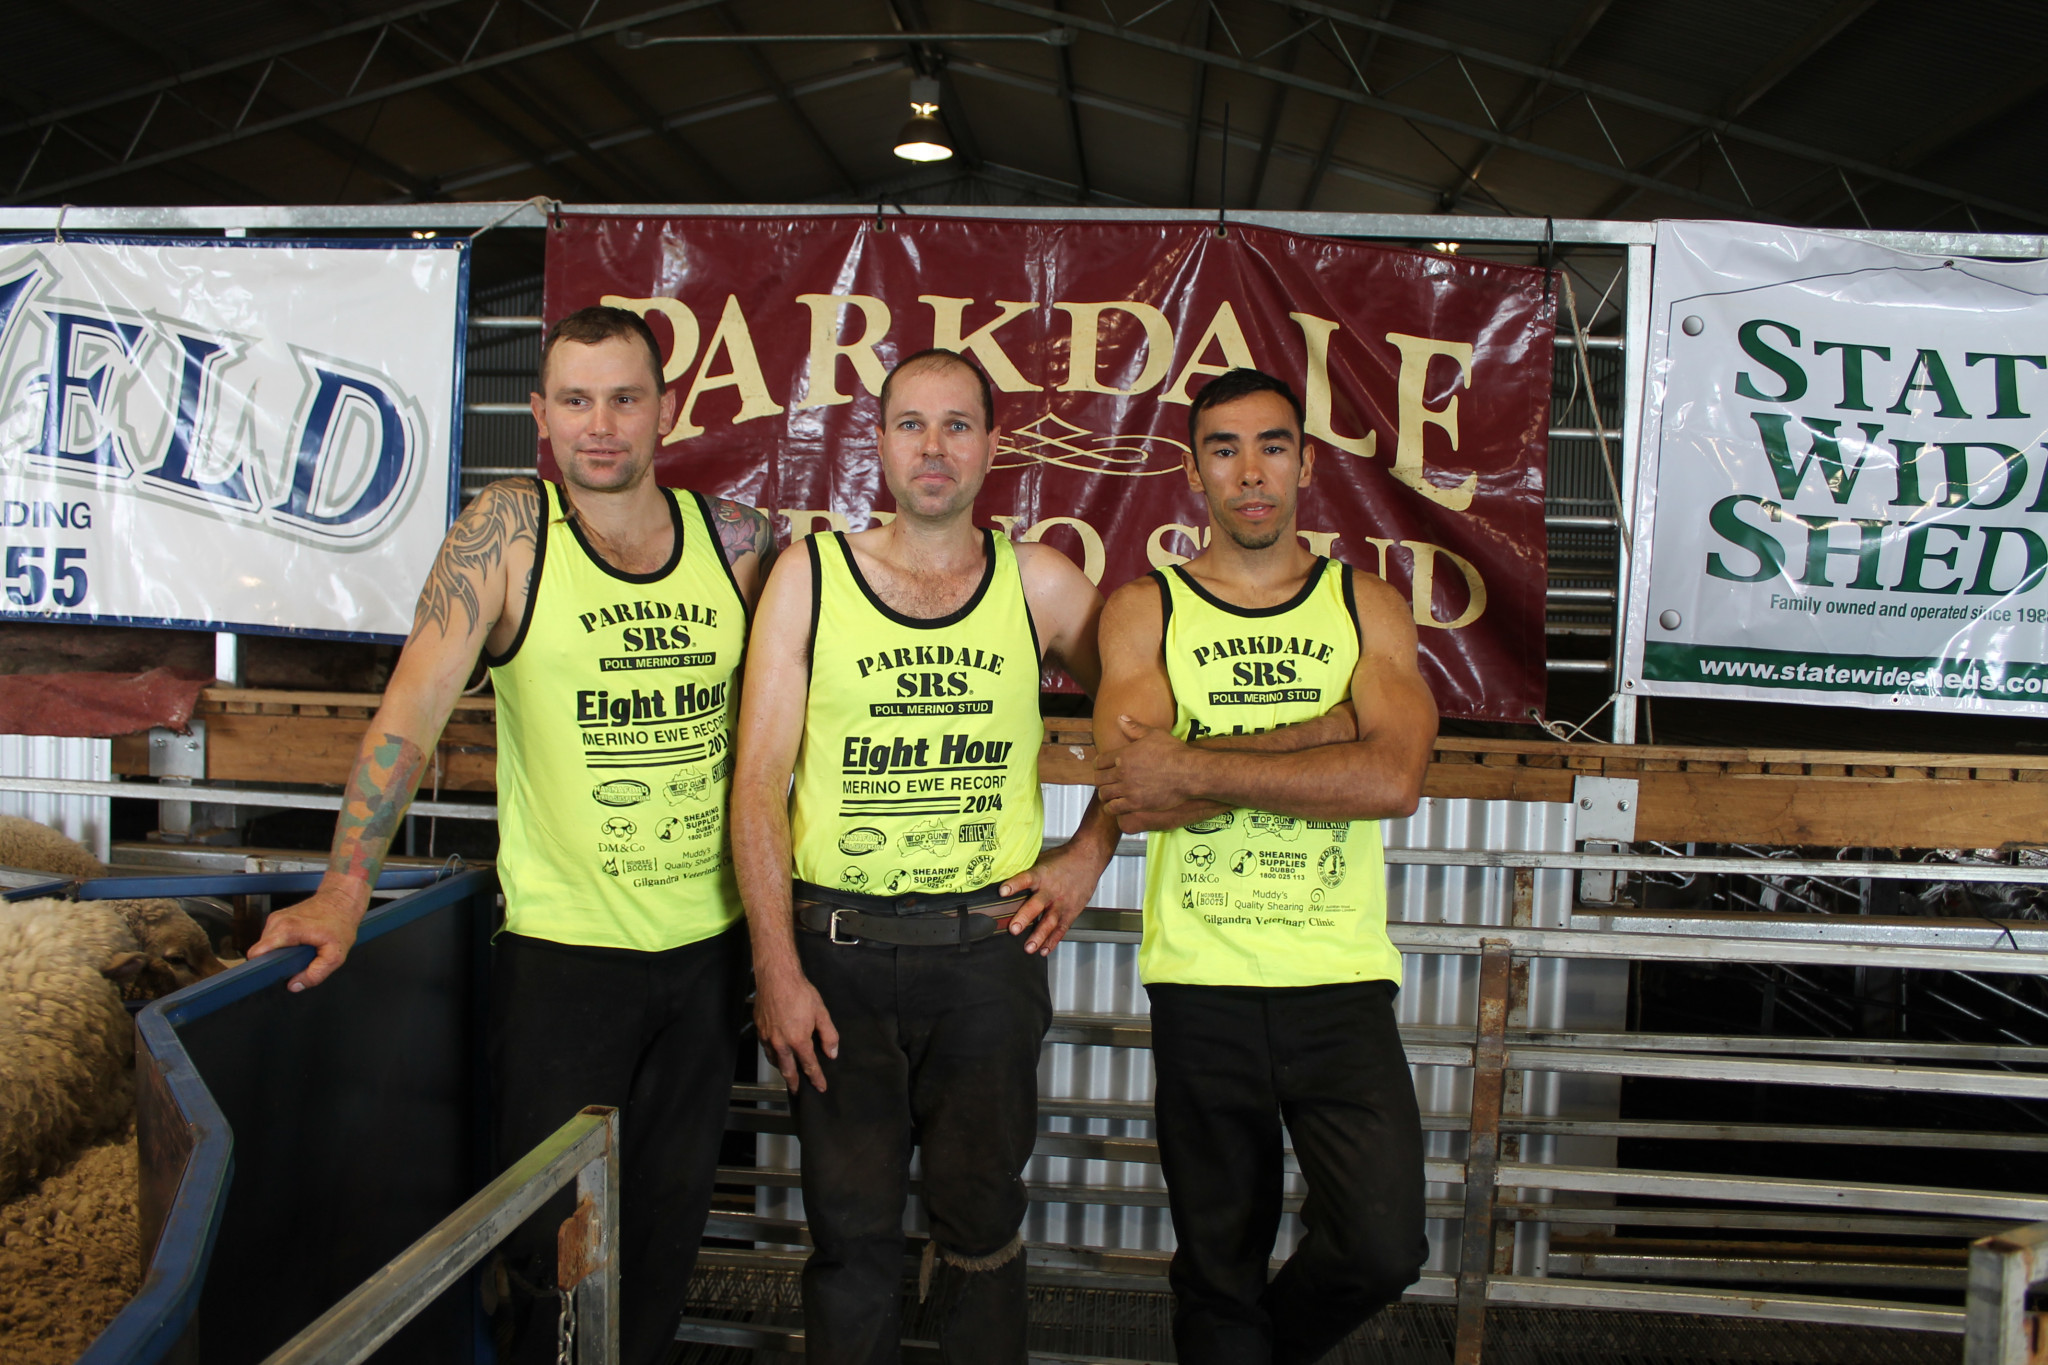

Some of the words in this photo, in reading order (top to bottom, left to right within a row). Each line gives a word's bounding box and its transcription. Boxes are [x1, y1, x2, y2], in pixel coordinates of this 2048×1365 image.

[0, 500, 92, 529] DING
[1705, 493, 2048, 596] SHED
[1769, 593, 1821, 615] Family
[1826, 601, 1877, 616] owned
[1879, 603, 1907, 618] and
[1910, 604, 1968, 621] operated
[1970, 606, 2012, 622] since
[2016, 607, 2048, 623] 198
[578, 600, 718, 633] PARKDALE
[1193, 636, 1334, 667] PARKDALE
[604, 659, 632, 669] POLL
[635, 656, 680, 668] MERINO
[683, 654, 713, 665] STUD
[856, 645, 1005, 678] PARKDALE
[1212, 693, 1241, 703] POLL
[1244, 692, 1283, 703] MERINO
[1287, 690, 1318, 700] STUD
[576, 689, 666, 727] Eight
[675, 681, 727, 716] Hour
[875, 705, 903, 715] POLL
[906, 703, 954, 715] MERINO
[958, 702, 989, 713] STUD
[582, 731, 649, 746] MERINO
[655, 727, 690, 743] EWE
[842, 737, 930, 775] Eight
[939, 734, 1013, 765] Hour
[842, 780, 901, 794] MERINO
[906, 777, 945, 793] EWE
[951, 775, 1007, 790] RECORD
[962, 793, 1003, 814] 2014
[683, 806, 720, 822] SHEARING
[685, 813, 720, 829] SUPPLIES
[598, 842, 646, 853] DM&Co
[682, 847, 711, 859] Muddy's
[1258, 850, 1308, 860] SHEARING
[627, 864, 653, 872] BOOTS
[664, 860, 692, 870] Quality
[1259, 858, 1306, 868] SUPPLIES
[912, 867, 959, 876] SHEARING
[1293, 873, 1305, 881] 113
[633, 875, 679, 887] Gilgandra
[914, 874, 956, 883] SUPPLIES
[1180, 873, 1220, 884] DM&Co
[1252, 889, 1288, 900] Muddy's
[1200, 898, 1224, 906] BOOTS
[1234, 900, 1265, 911] Quality
[1267, 901, 1304, 913] Shearing
[1203, 914, 1252, 925] Gilgandra
[1255, 916, 1306, 929] Veterinary
[1308, 917, 1336, 927] Clinic
